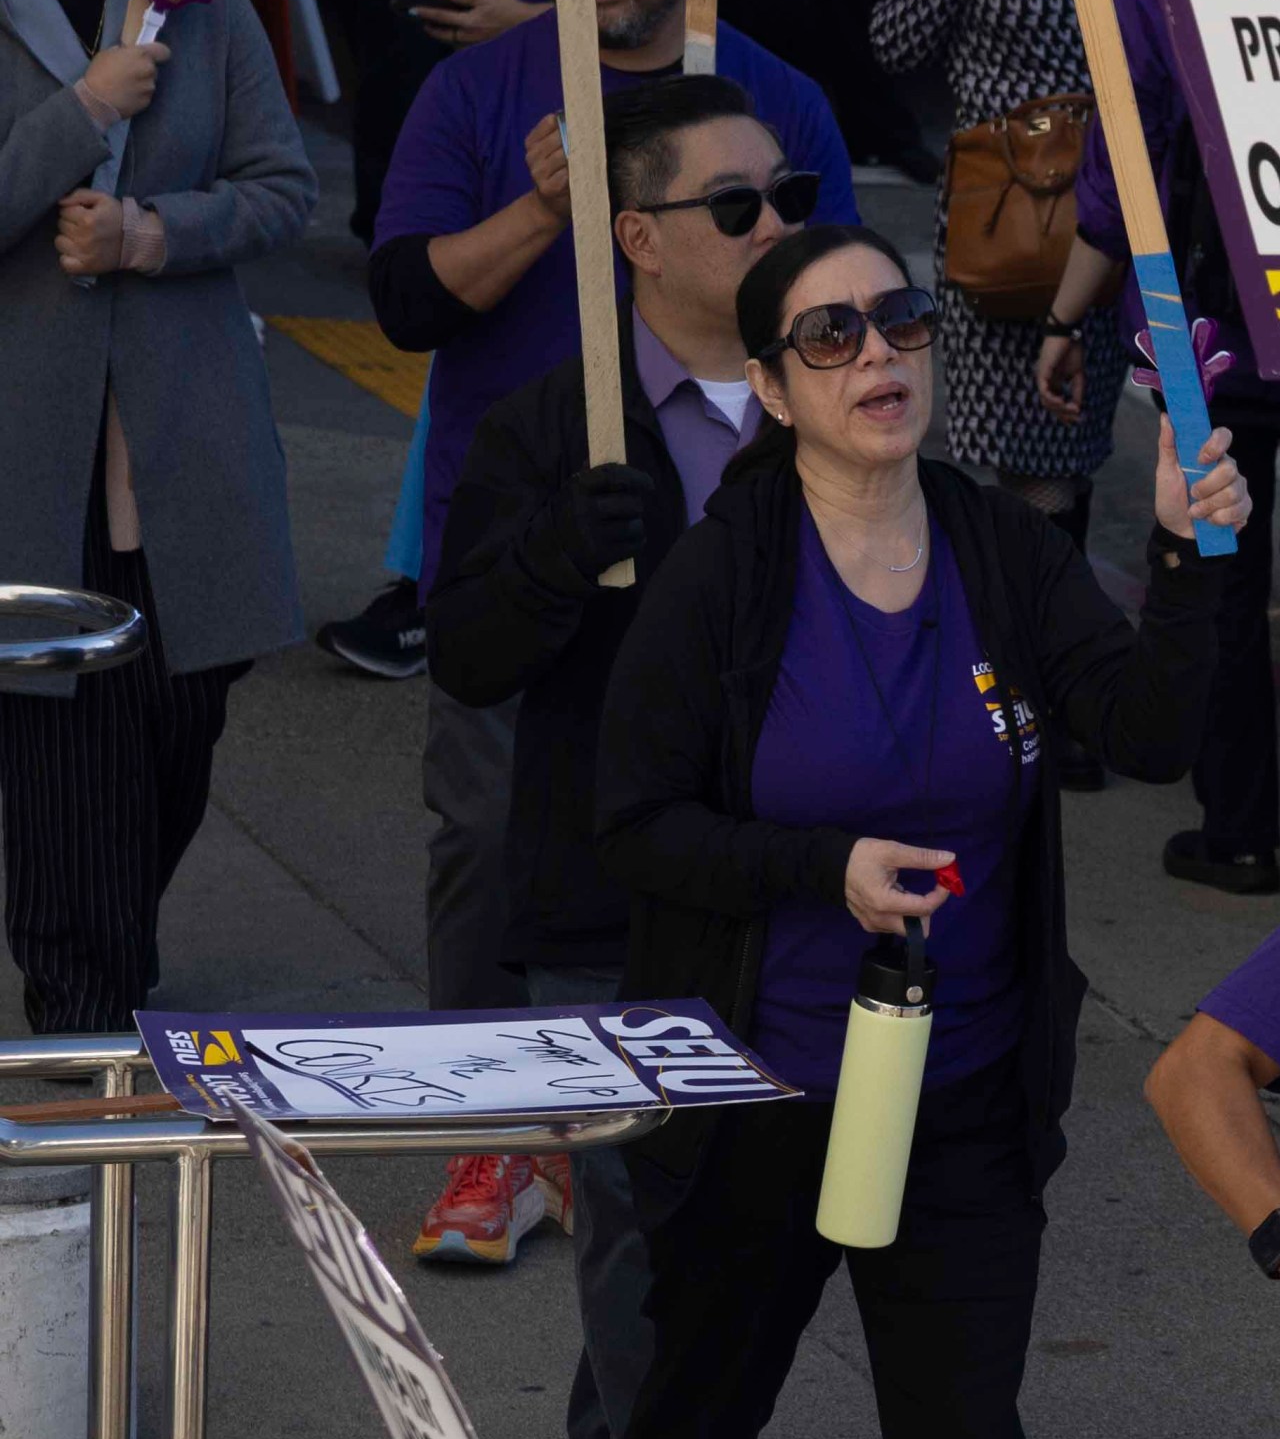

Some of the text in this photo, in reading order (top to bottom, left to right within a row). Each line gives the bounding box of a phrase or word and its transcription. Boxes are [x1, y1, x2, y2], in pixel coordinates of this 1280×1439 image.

[165, 1029, 203, 1066] SEIU
[275, 1039, 467, 1108] COURTS
[599, 1015, 777, 1094] SEIU
